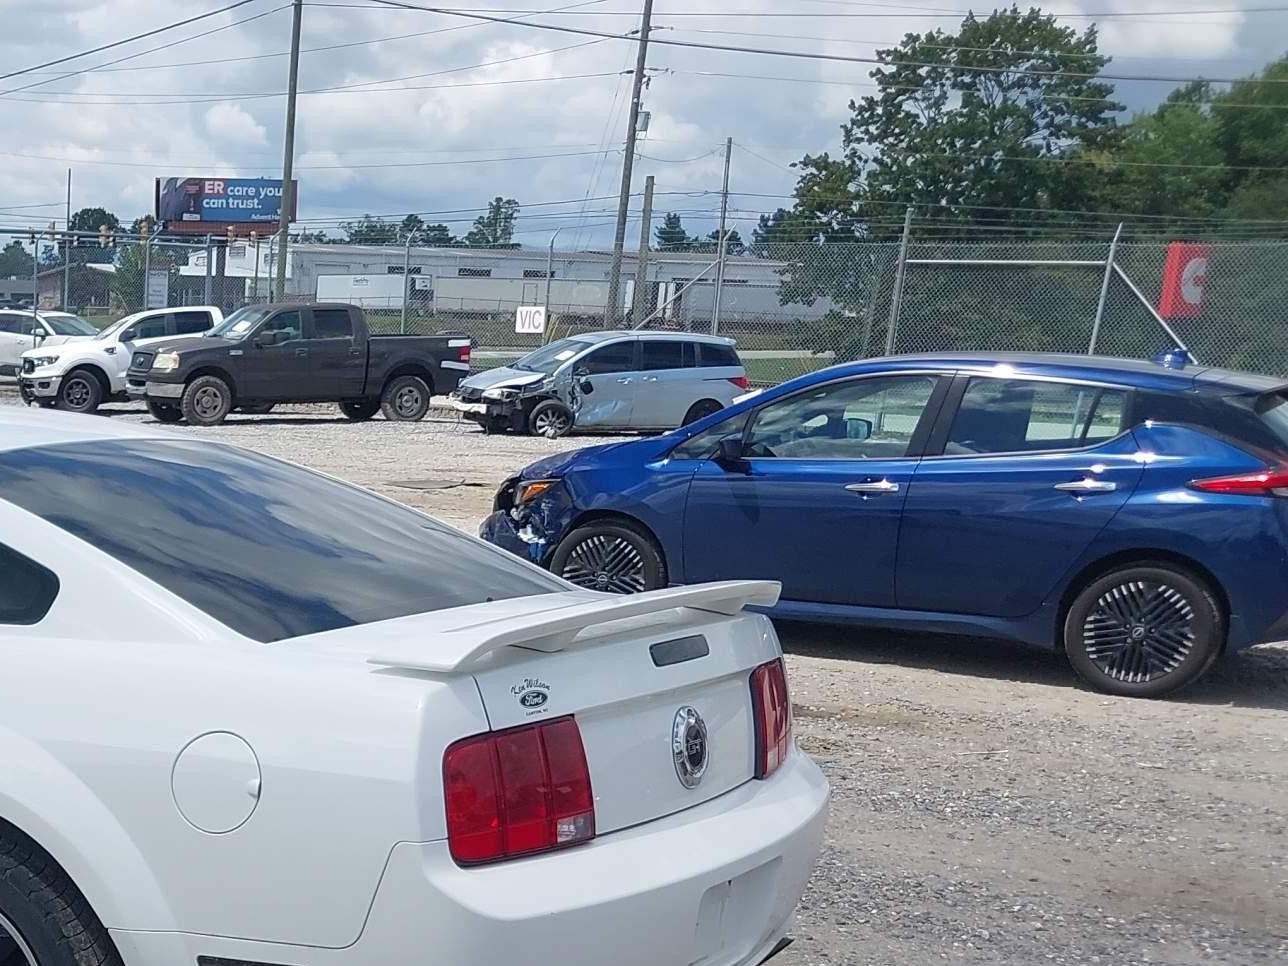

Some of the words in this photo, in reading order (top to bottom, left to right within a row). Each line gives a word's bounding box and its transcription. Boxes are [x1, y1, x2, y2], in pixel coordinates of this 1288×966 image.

[204, 181, 224, 194] ER
[227, 186, 256, 196] care
[260, 187, 283, 198] you
[203, 198, 226, 208] can
[229, 198, 262, 209] trust.
[520, 310, 542, 329] VIC
